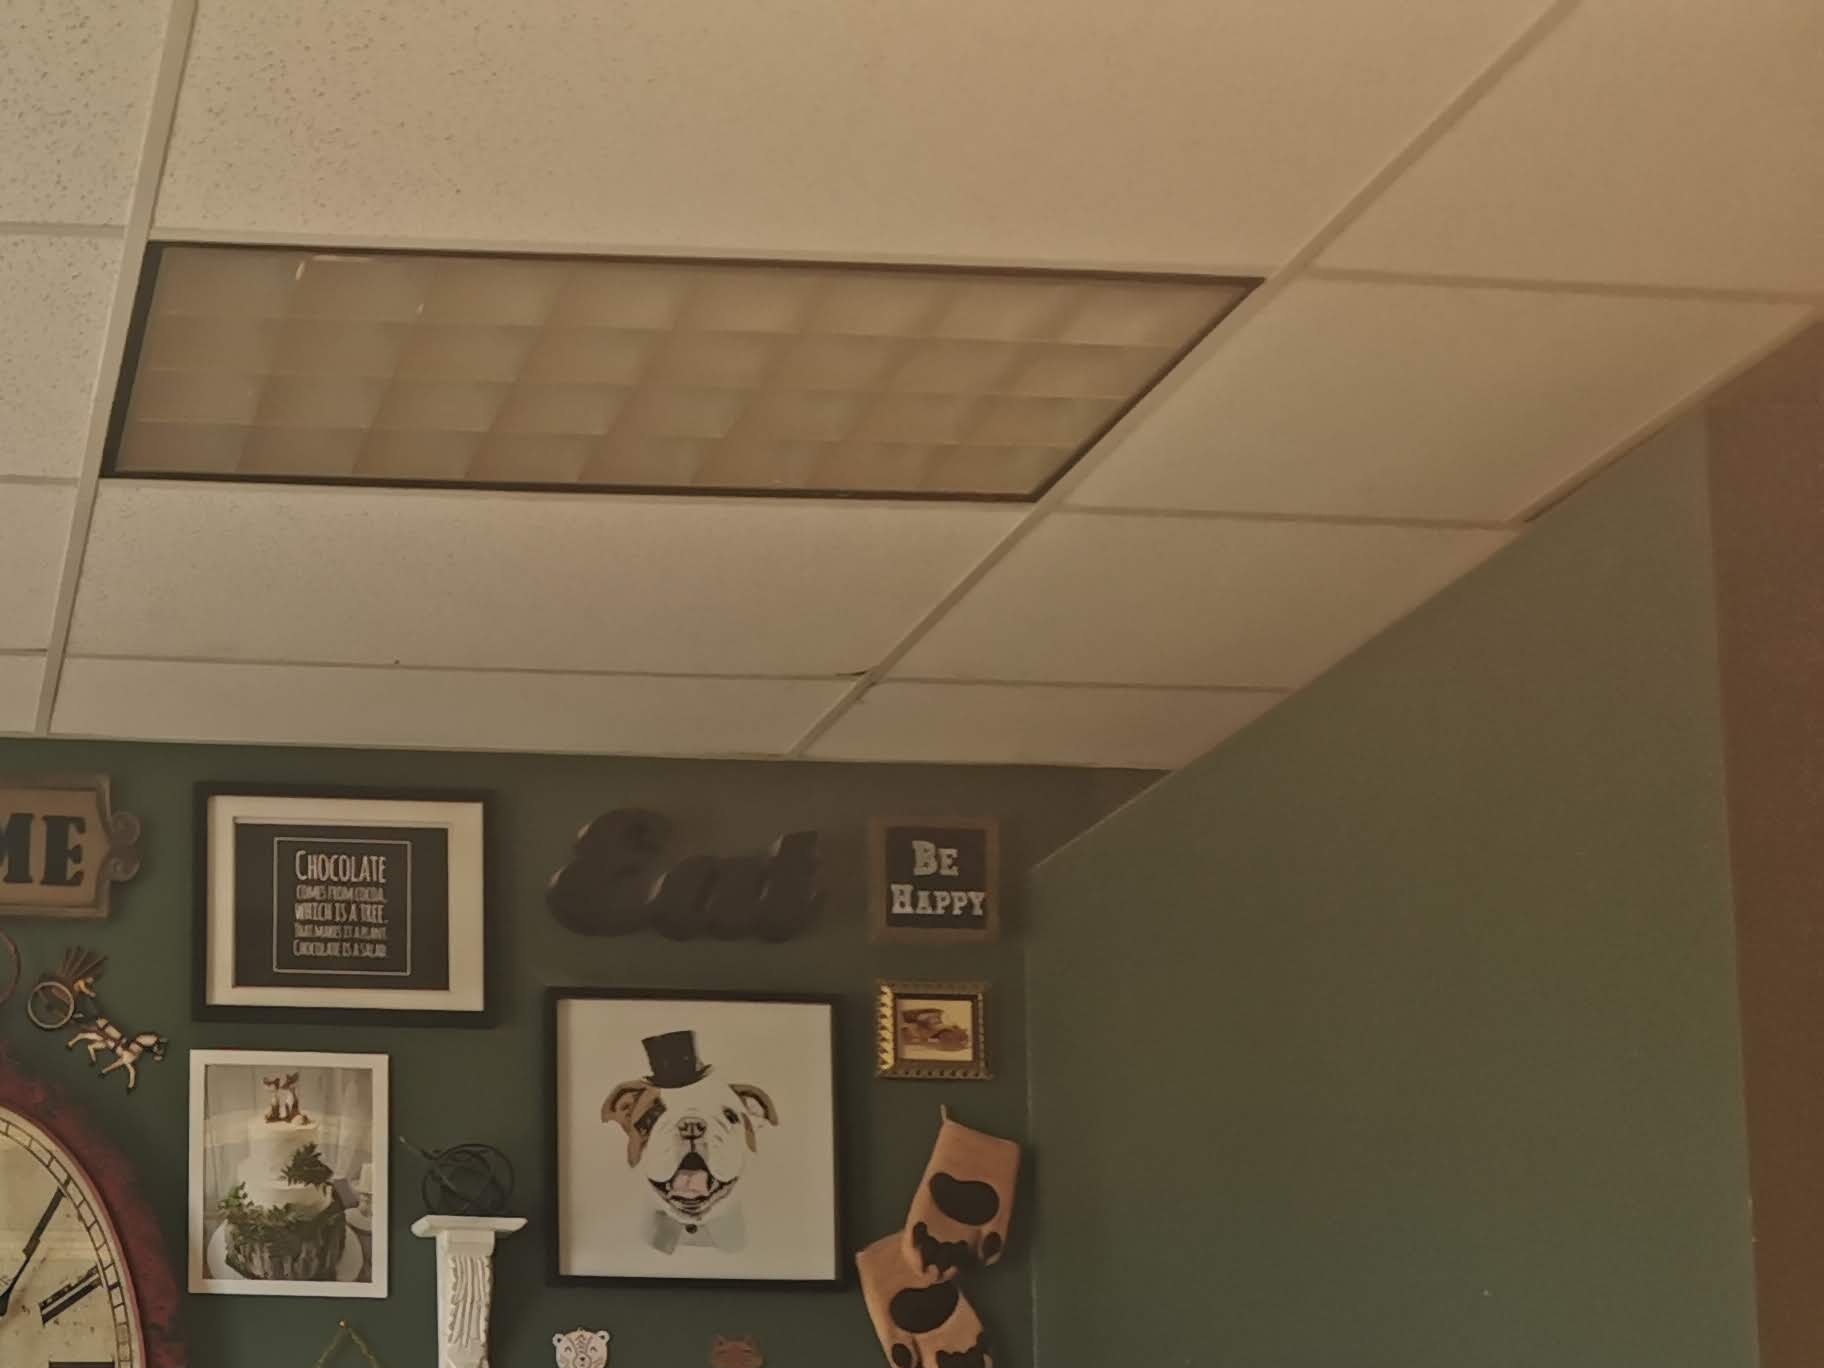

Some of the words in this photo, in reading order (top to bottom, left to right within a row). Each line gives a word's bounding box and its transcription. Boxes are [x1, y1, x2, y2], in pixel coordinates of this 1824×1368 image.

[295, 850, 387, 883] CHOCOLATE
[911, 840, 960, 877] BE
[294, 902, 333, 921] WHICH
[335, 902, 348, 922] IS
[349, 903, 358, 922] A
[889, 883, 986, 916] HAPPY
